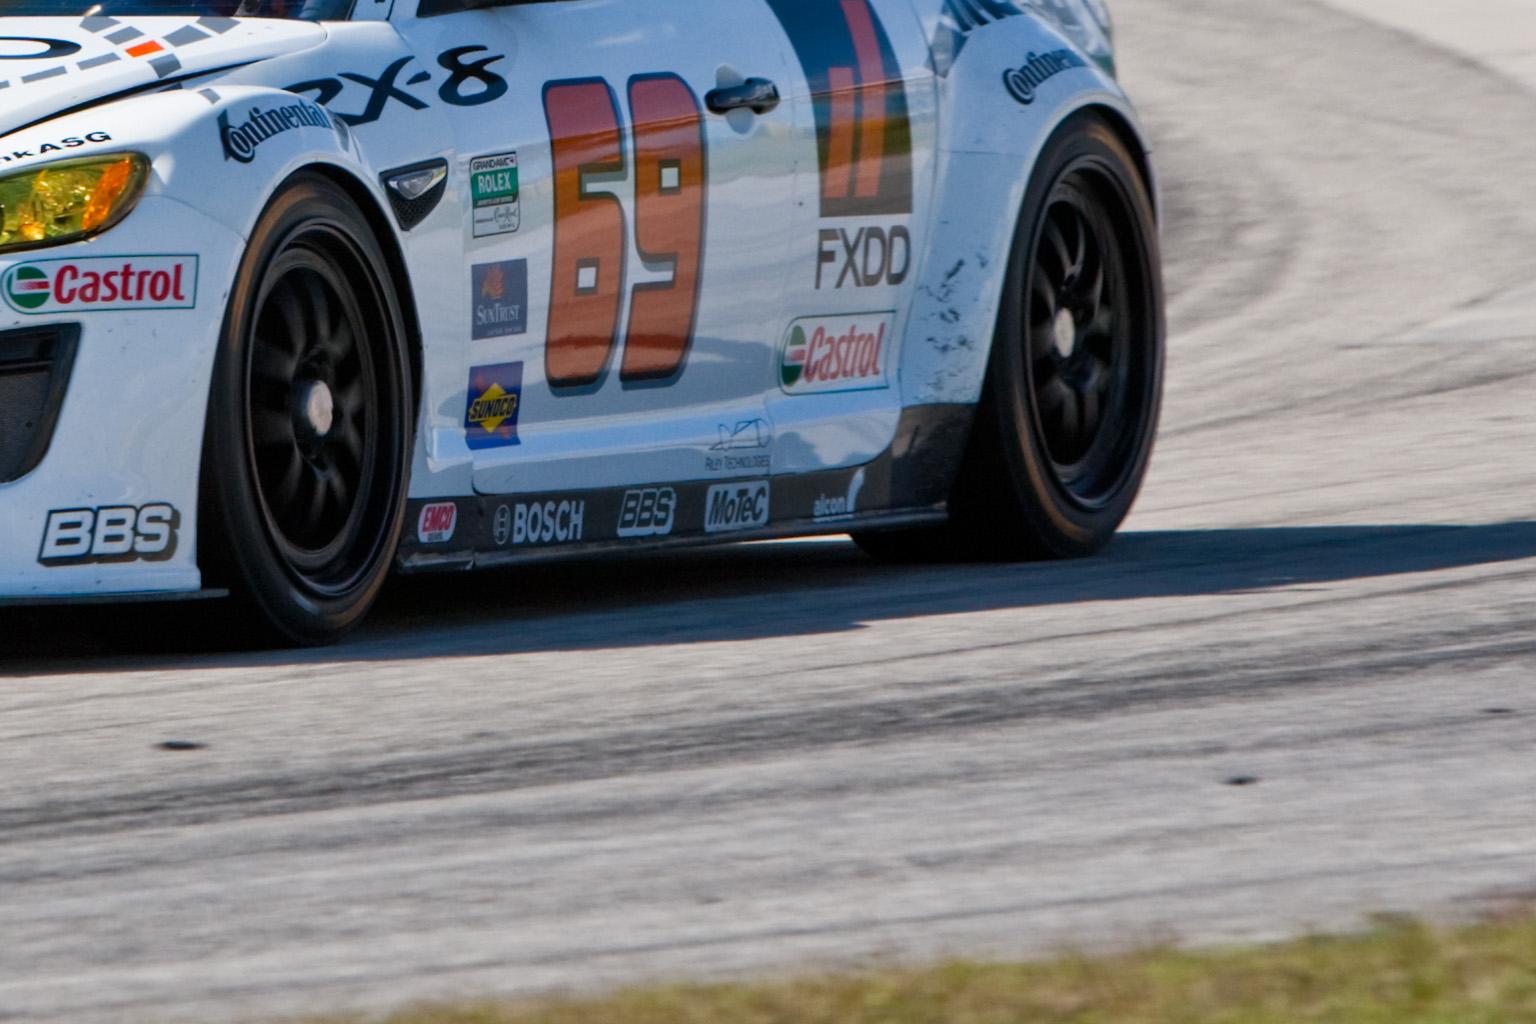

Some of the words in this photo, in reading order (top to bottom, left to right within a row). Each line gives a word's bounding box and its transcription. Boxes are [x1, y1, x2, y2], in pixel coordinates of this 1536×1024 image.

[219, 99, 334, 164] Continental
[477, 172, 511, 194] ROLEX
[541, 71, 709, 397] 69
[814, 225, 912, 290] FXDD
[52, 263, 185, 305] Castrol
[805, 322, 886, 383] Castrol
[470, 394, 515, 420] SUNOCO
[422, 505, 455, 533] EMCO
[513, 500, 585, 543] BOSCH
[617, 487, 677, 537] BBS
[708, 487, 767, 526] MoTeC
[37, 503, 181, 567] BBS
